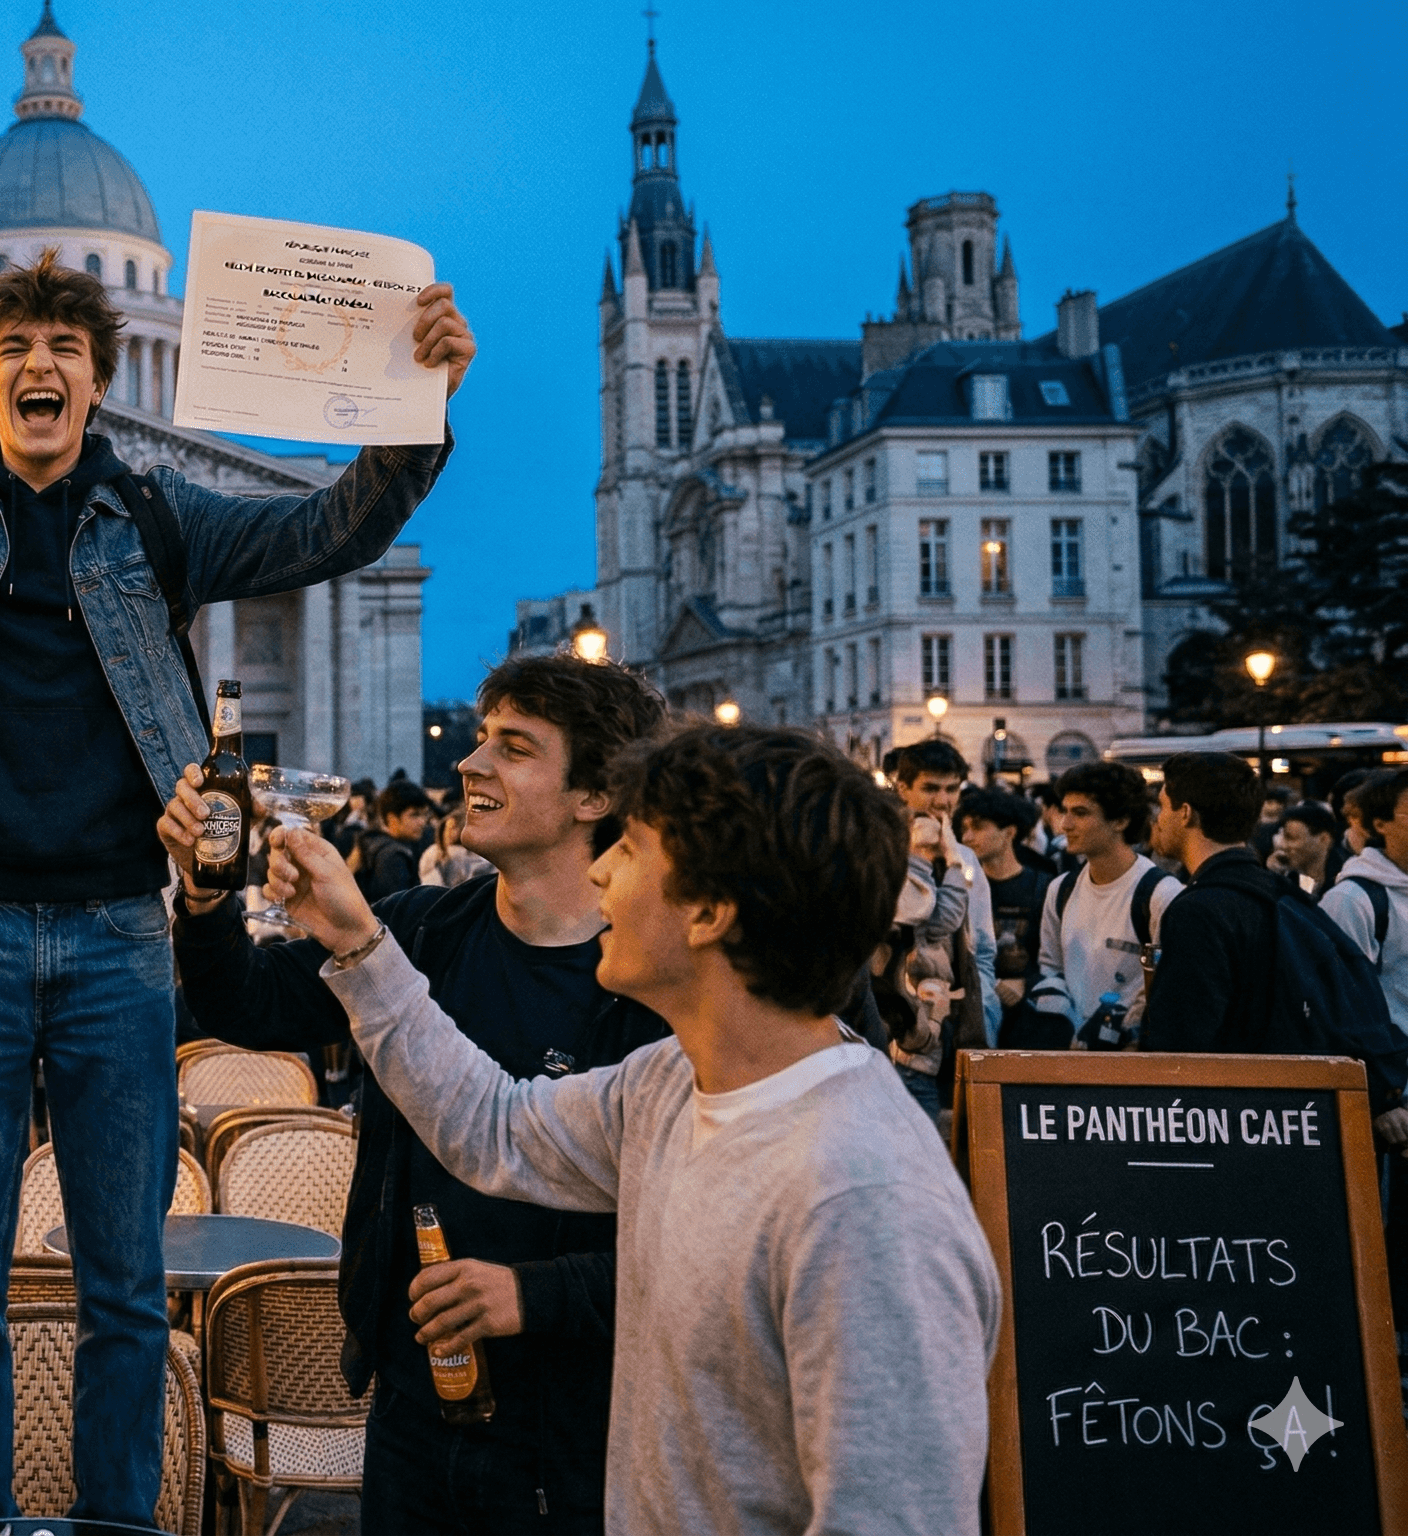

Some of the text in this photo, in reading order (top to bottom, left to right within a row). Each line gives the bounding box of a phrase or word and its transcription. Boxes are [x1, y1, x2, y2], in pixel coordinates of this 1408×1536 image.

[1020, 1099, 1321, 1147] LE PANTHÉON CAFÉ
[1041, 1211, 1296, 1286] RÉSULTATS
[1092, 1306, 1152, 1354] DU
[1174, 1308, 1269, 1359] BAC
[1046, 1381, 1227, 1448] FÊTONS
